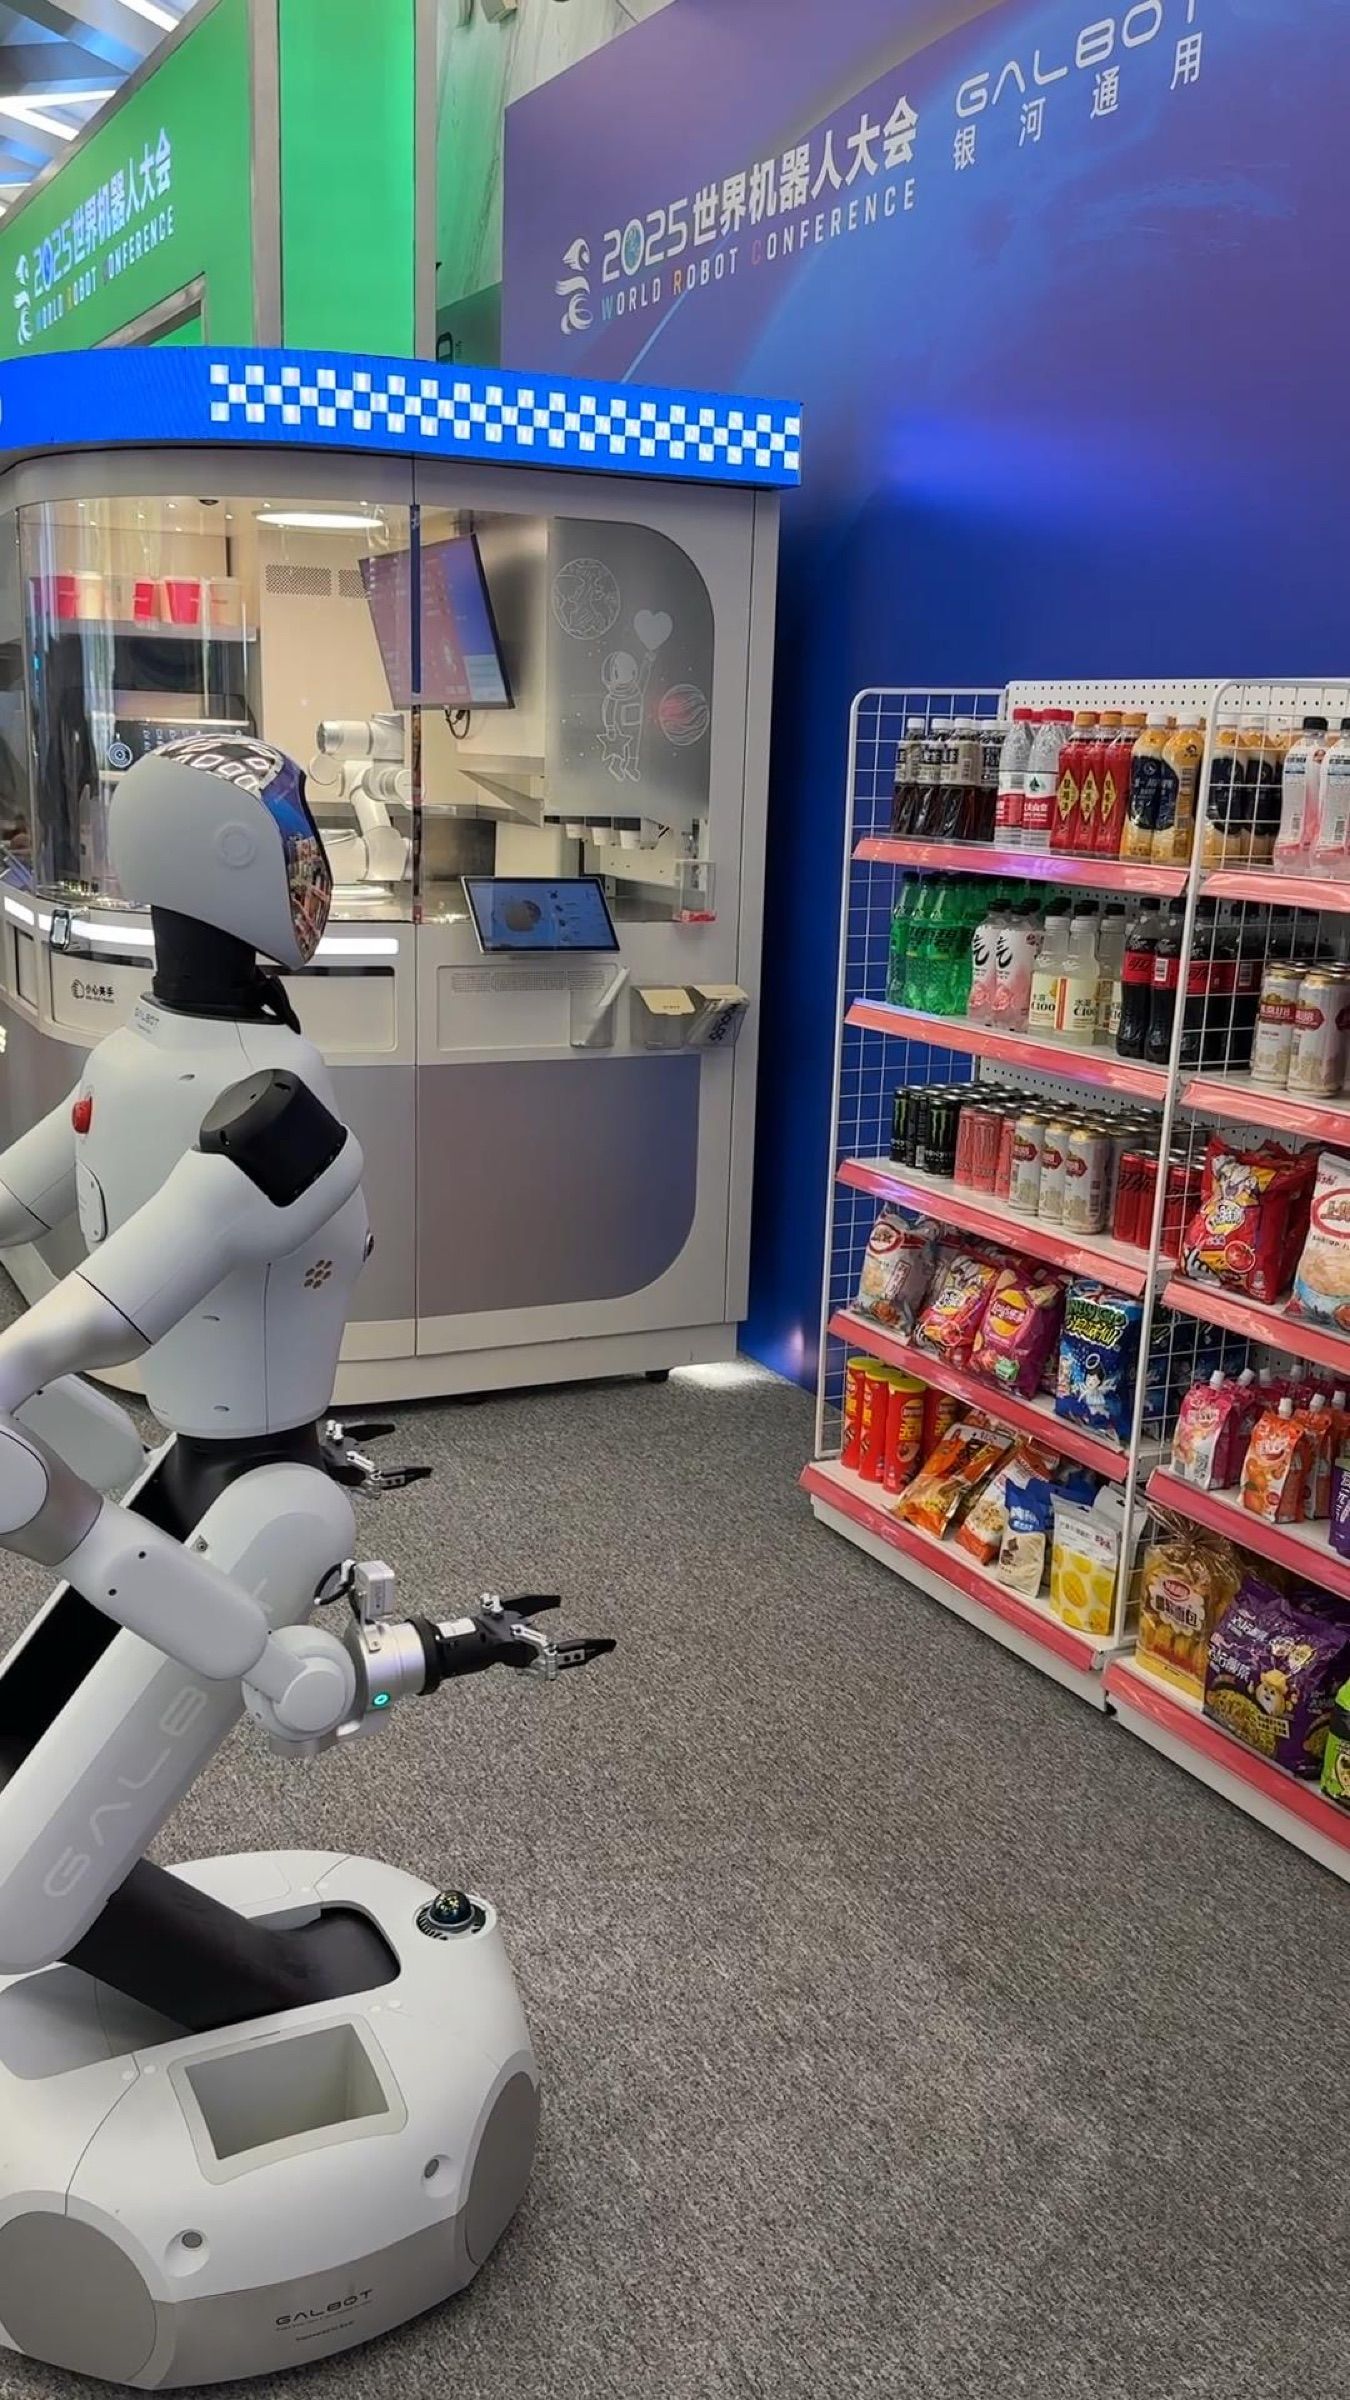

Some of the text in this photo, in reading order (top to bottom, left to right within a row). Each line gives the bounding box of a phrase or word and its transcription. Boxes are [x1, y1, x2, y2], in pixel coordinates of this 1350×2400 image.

[953, 32, 1203, 171] 银河通用
[33, 127, 172, 298] 2025世界机器人大会
[601, 96, 919, 284] 2025世界机器人大会
[601, 178, 917, 321] WORLD ROBOT CONFERENCE
[275, 2289, 373, 2326] GALBOT
